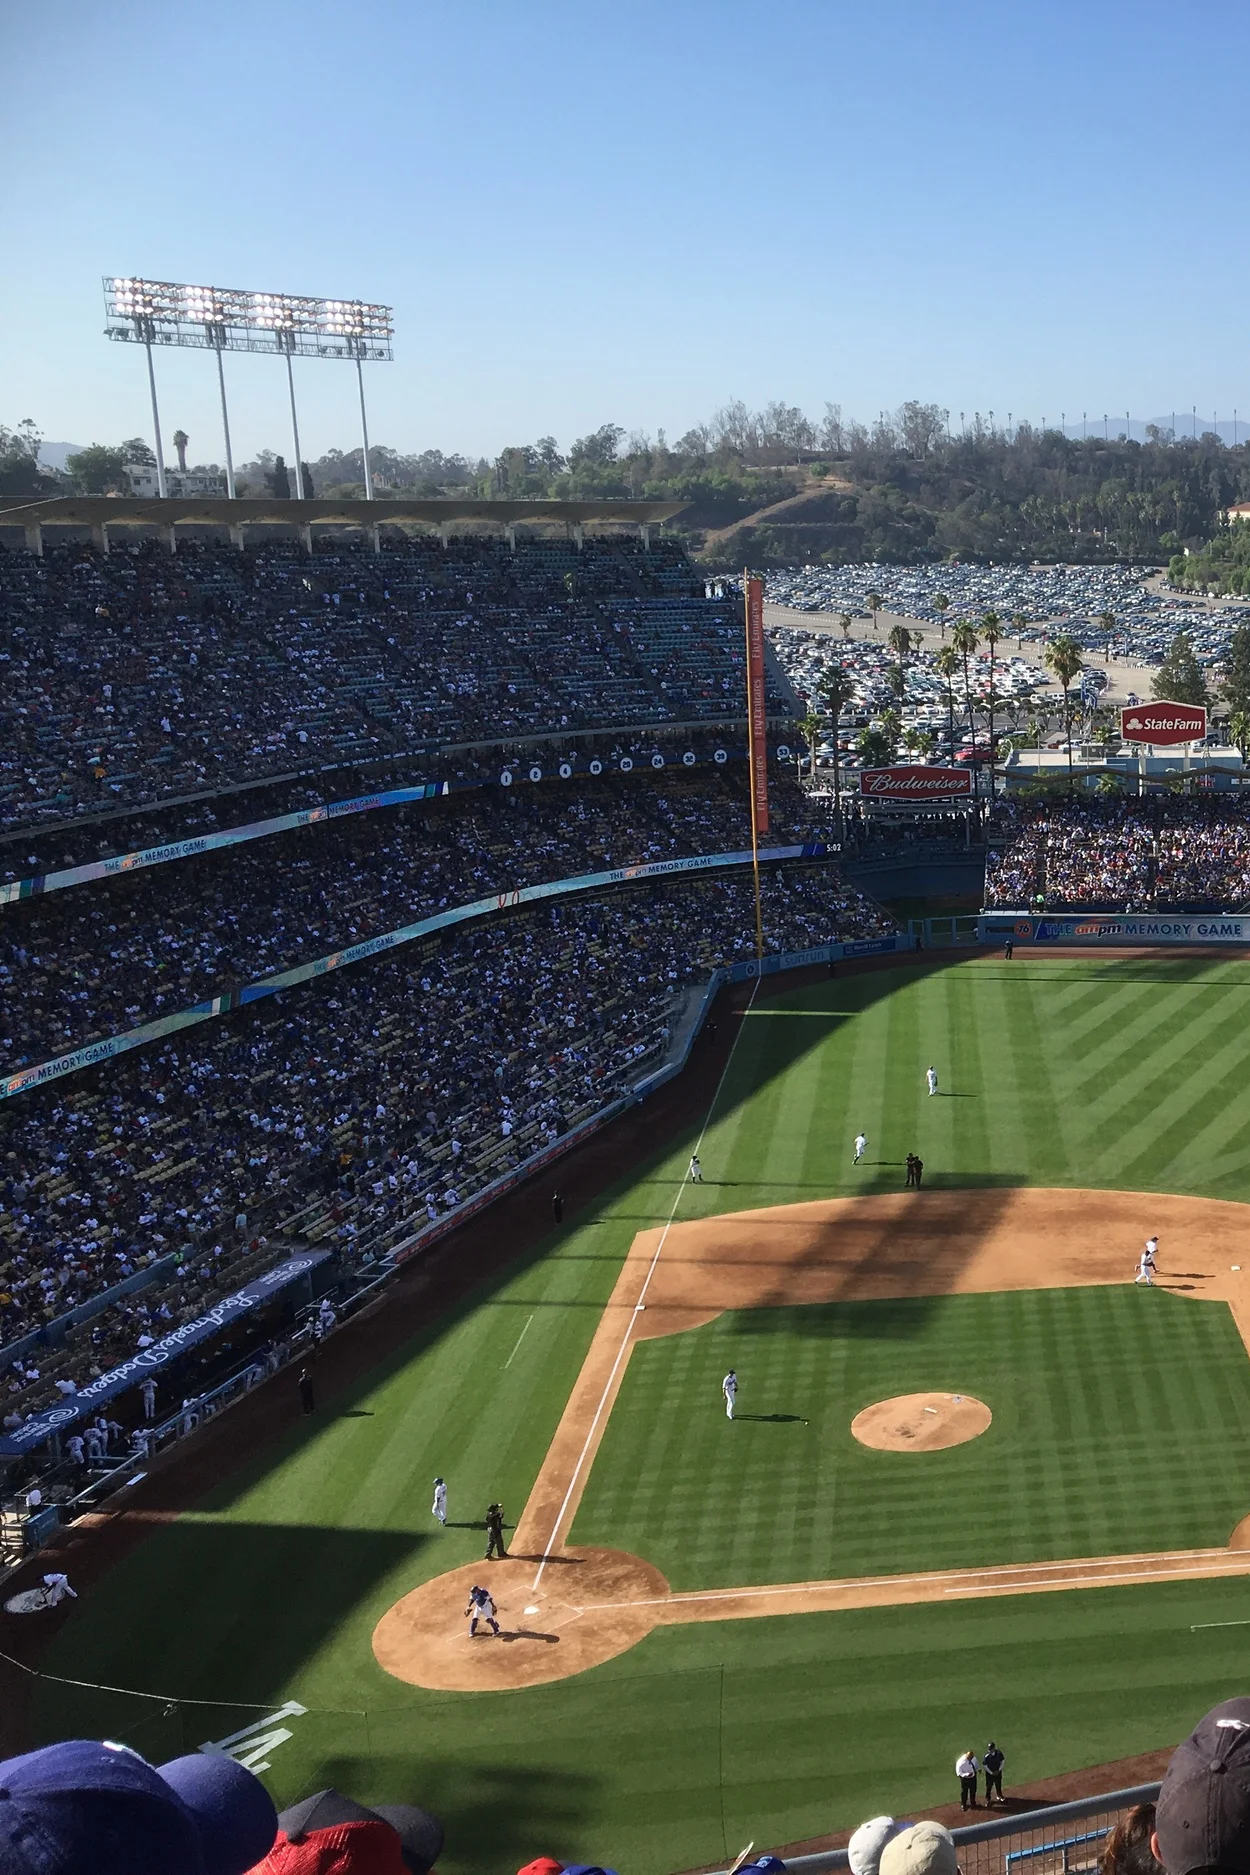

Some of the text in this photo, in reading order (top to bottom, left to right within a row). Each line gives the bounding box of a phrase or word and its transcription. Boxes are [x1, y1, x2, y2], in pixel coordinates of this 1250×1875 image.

[753, 679, 762, 736] Fly Emirates
[756, 756, 766, 811] Fly Emirates
[865, 774, 968, 791] Budweiser
[104, 860, 119, 871] THE
[145, 847, 180, 861] MEMORY
[183, 840, 206, 853] GAME
[826, 843, 841, 852] 5:02
[610, 871, 623, 880] THE
[649, 861, 684, 873] MEMORY
[687, 858, 712, 868] GAME
[1017, 924, 1030, 934] 76
[1047, 922, 1242, 937] THE ampm MEMORY GAME
[346, 943, 374, 959] MEMORY
[375, 936, 394, 949] GAME
[785, 950, 825, 965] sunrun
[37, 1054, 82, 1080] MEMORY
[84, 1042, 113, 1061] GAME
[77, 1290, 260, 1399] Los Angeles Dodgers
